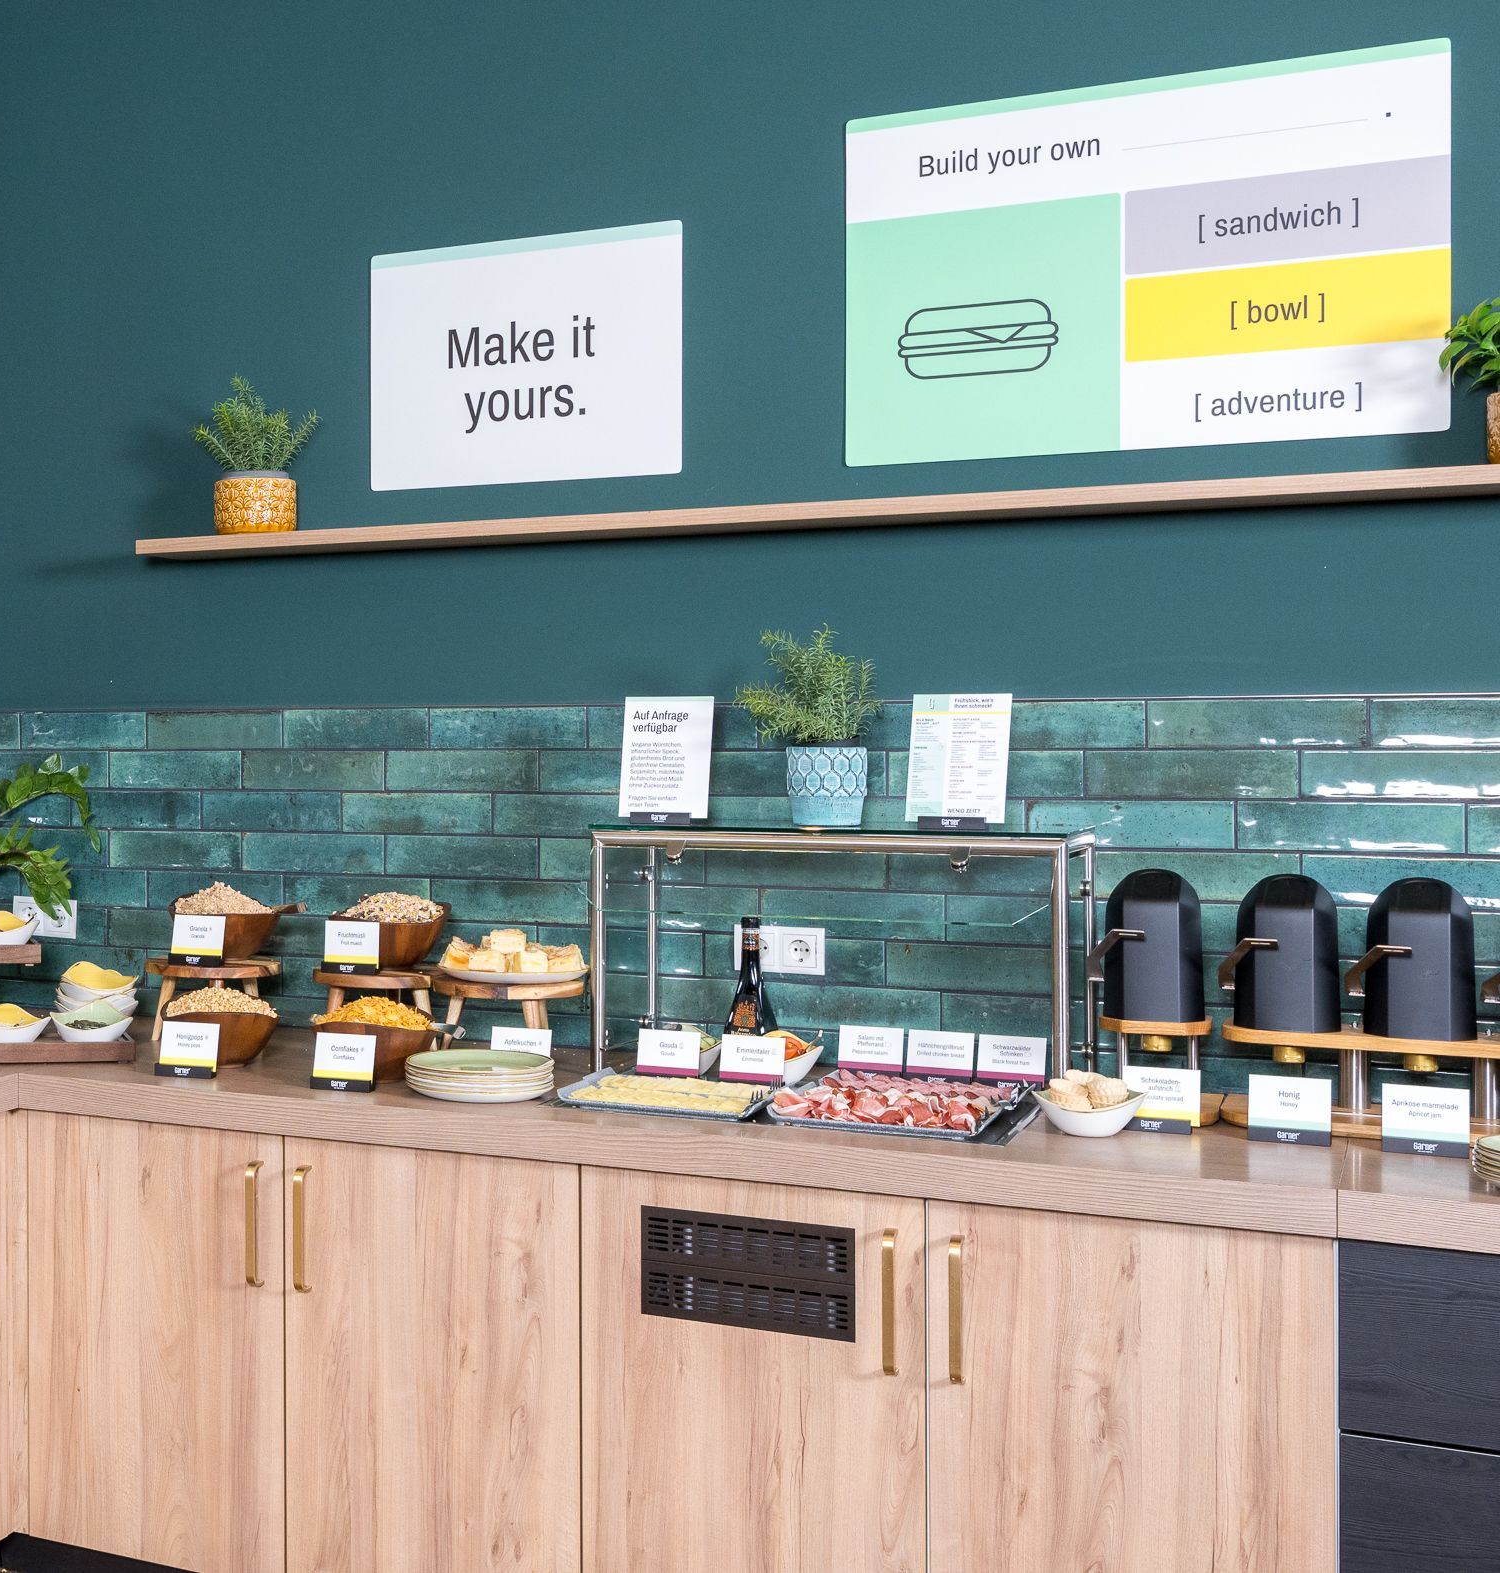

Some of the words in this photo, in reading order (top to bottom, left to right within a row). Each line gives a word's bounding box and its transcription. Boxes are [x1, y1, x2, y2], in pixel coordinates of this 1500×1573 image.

[918, 146, 980, 179] Build
[987, 142, 1041, 176] your
[1050, 136, 1101, 163] own
[1214, 203, 1342, 239] sandwich
[1246, 295, 1309, 326] bowl
[447, 321, 555, 369] Make
[572, 315, 595, 358] it
[464, 383, 586, 434] yours.
[1210, 387, 1345, 420] adventure
[633, 710, 650, 720] Auf
[651, 710, 689, 722] Anfrage
[633, 722, 678, 734] verfügbar
[176, 1033, 204, 1041] Honigpops
[330, 1045, 359, 1053] Cornflakes
[736, 1047, 770, 1055] Emmentaler
[1140, 1076, 1181, 1085] Schokoladen-
[1278, 1090, 1301, 1100] Honig
[1280, 1101, 1298, 1109] Honey
[1391, 1099, 1421, 1108] Aprikose
[1421, 1102, 1459, 1111] marmelade
[1408, 1110, 1430, 1118] Apricot
